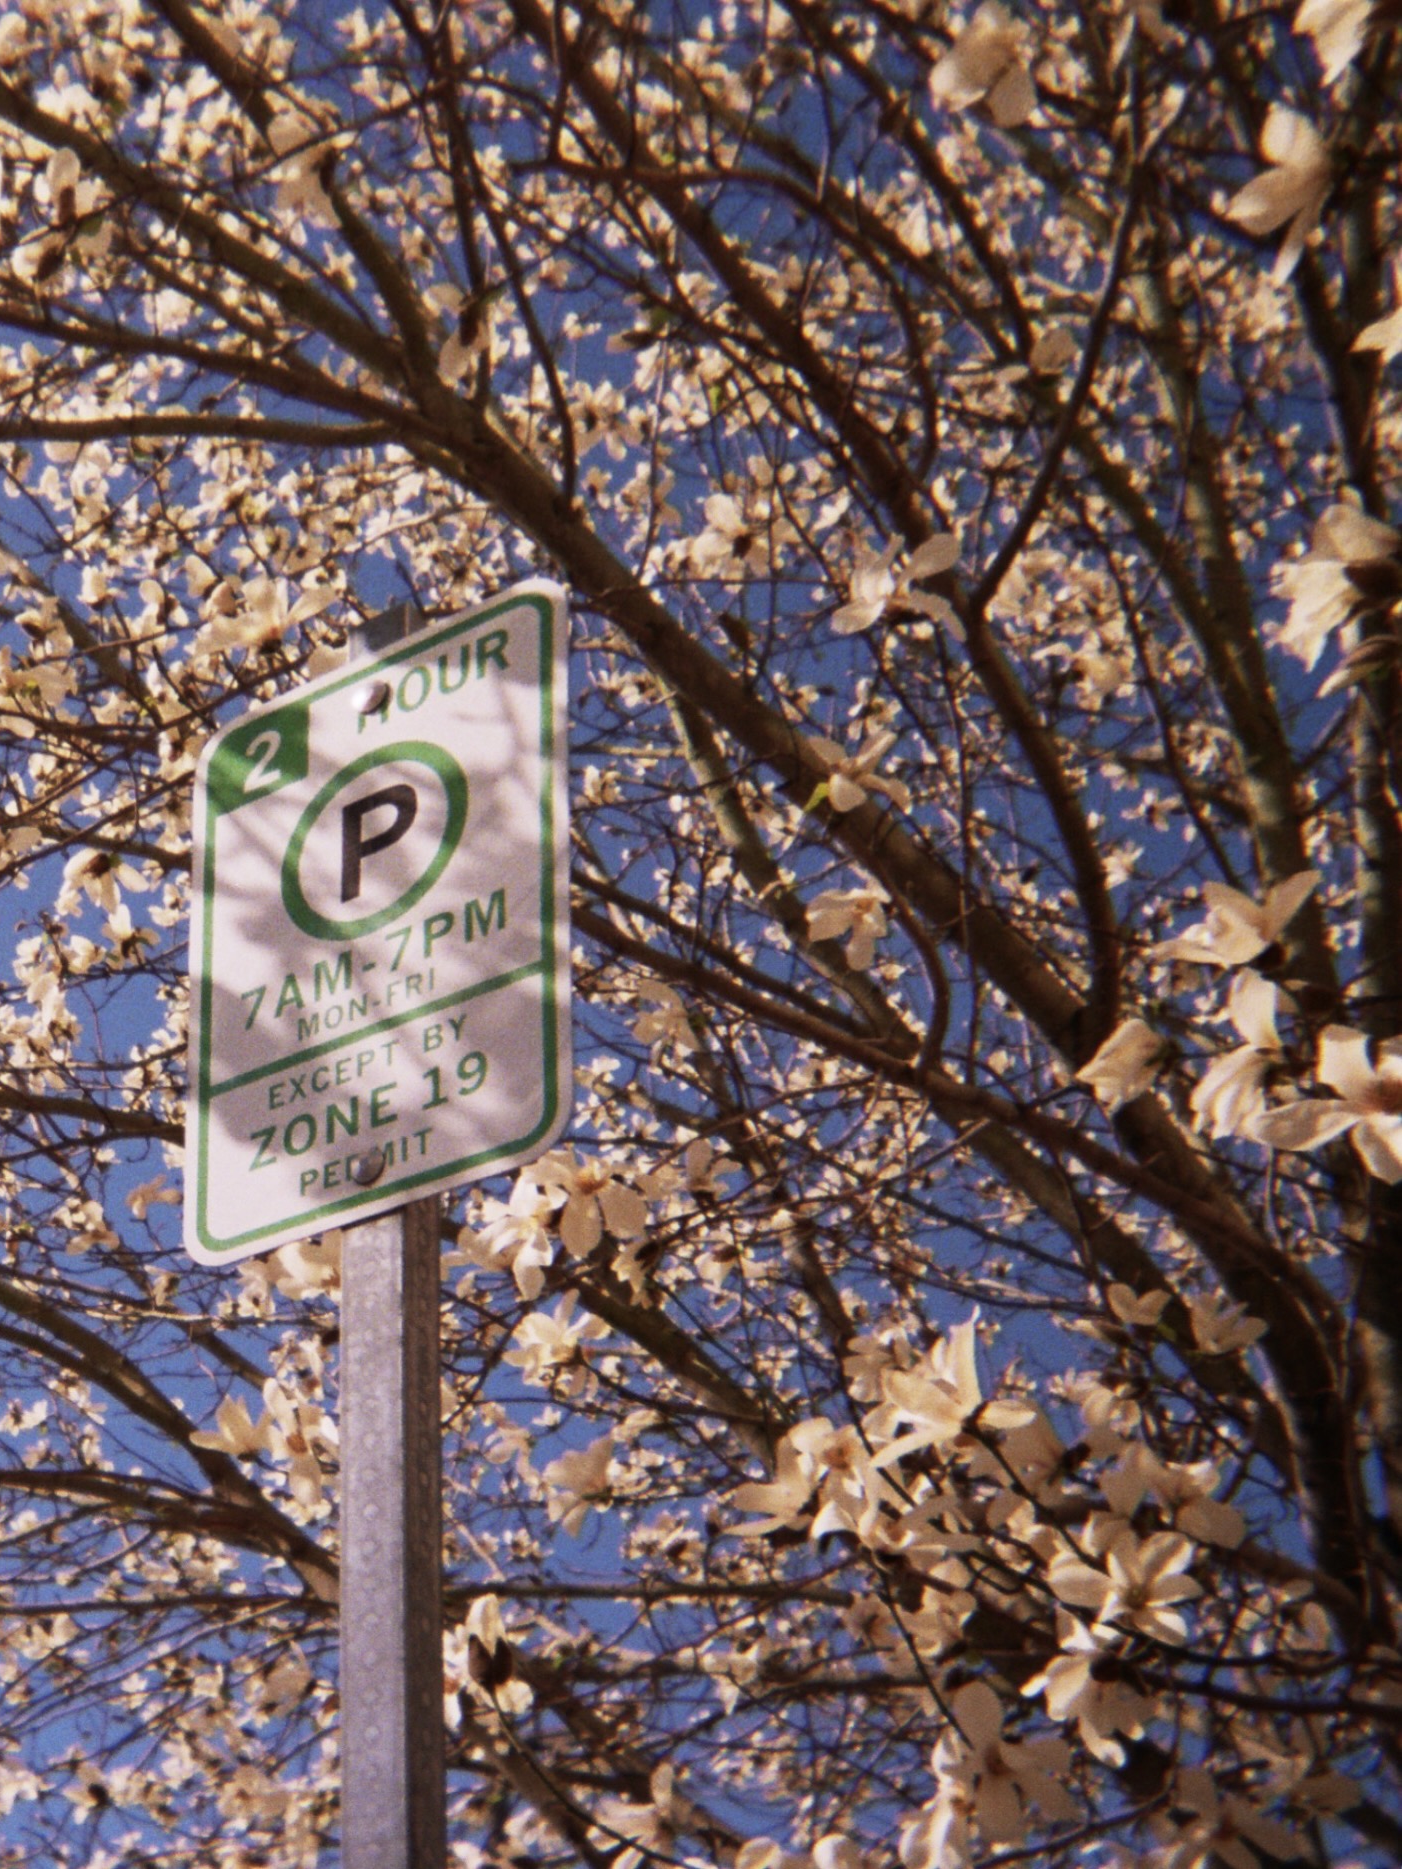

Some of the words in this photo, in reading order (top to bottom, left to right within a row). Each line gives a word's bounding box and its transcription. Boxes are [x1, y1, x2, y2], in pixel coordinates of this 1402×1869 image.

[243, 730, 282, 793] 2
[357, 629, 509, 734] OUR
[340, 783, 418, 904] P
[268, 1039, 398, 1110] EXCEPT
[423, 1012, 467, 1052] BY
[298, 967, 435, 1041] MON-FRI
[248, 1081, 398, 1172] ZONE
[422, 1051, 488, 1110] 19
